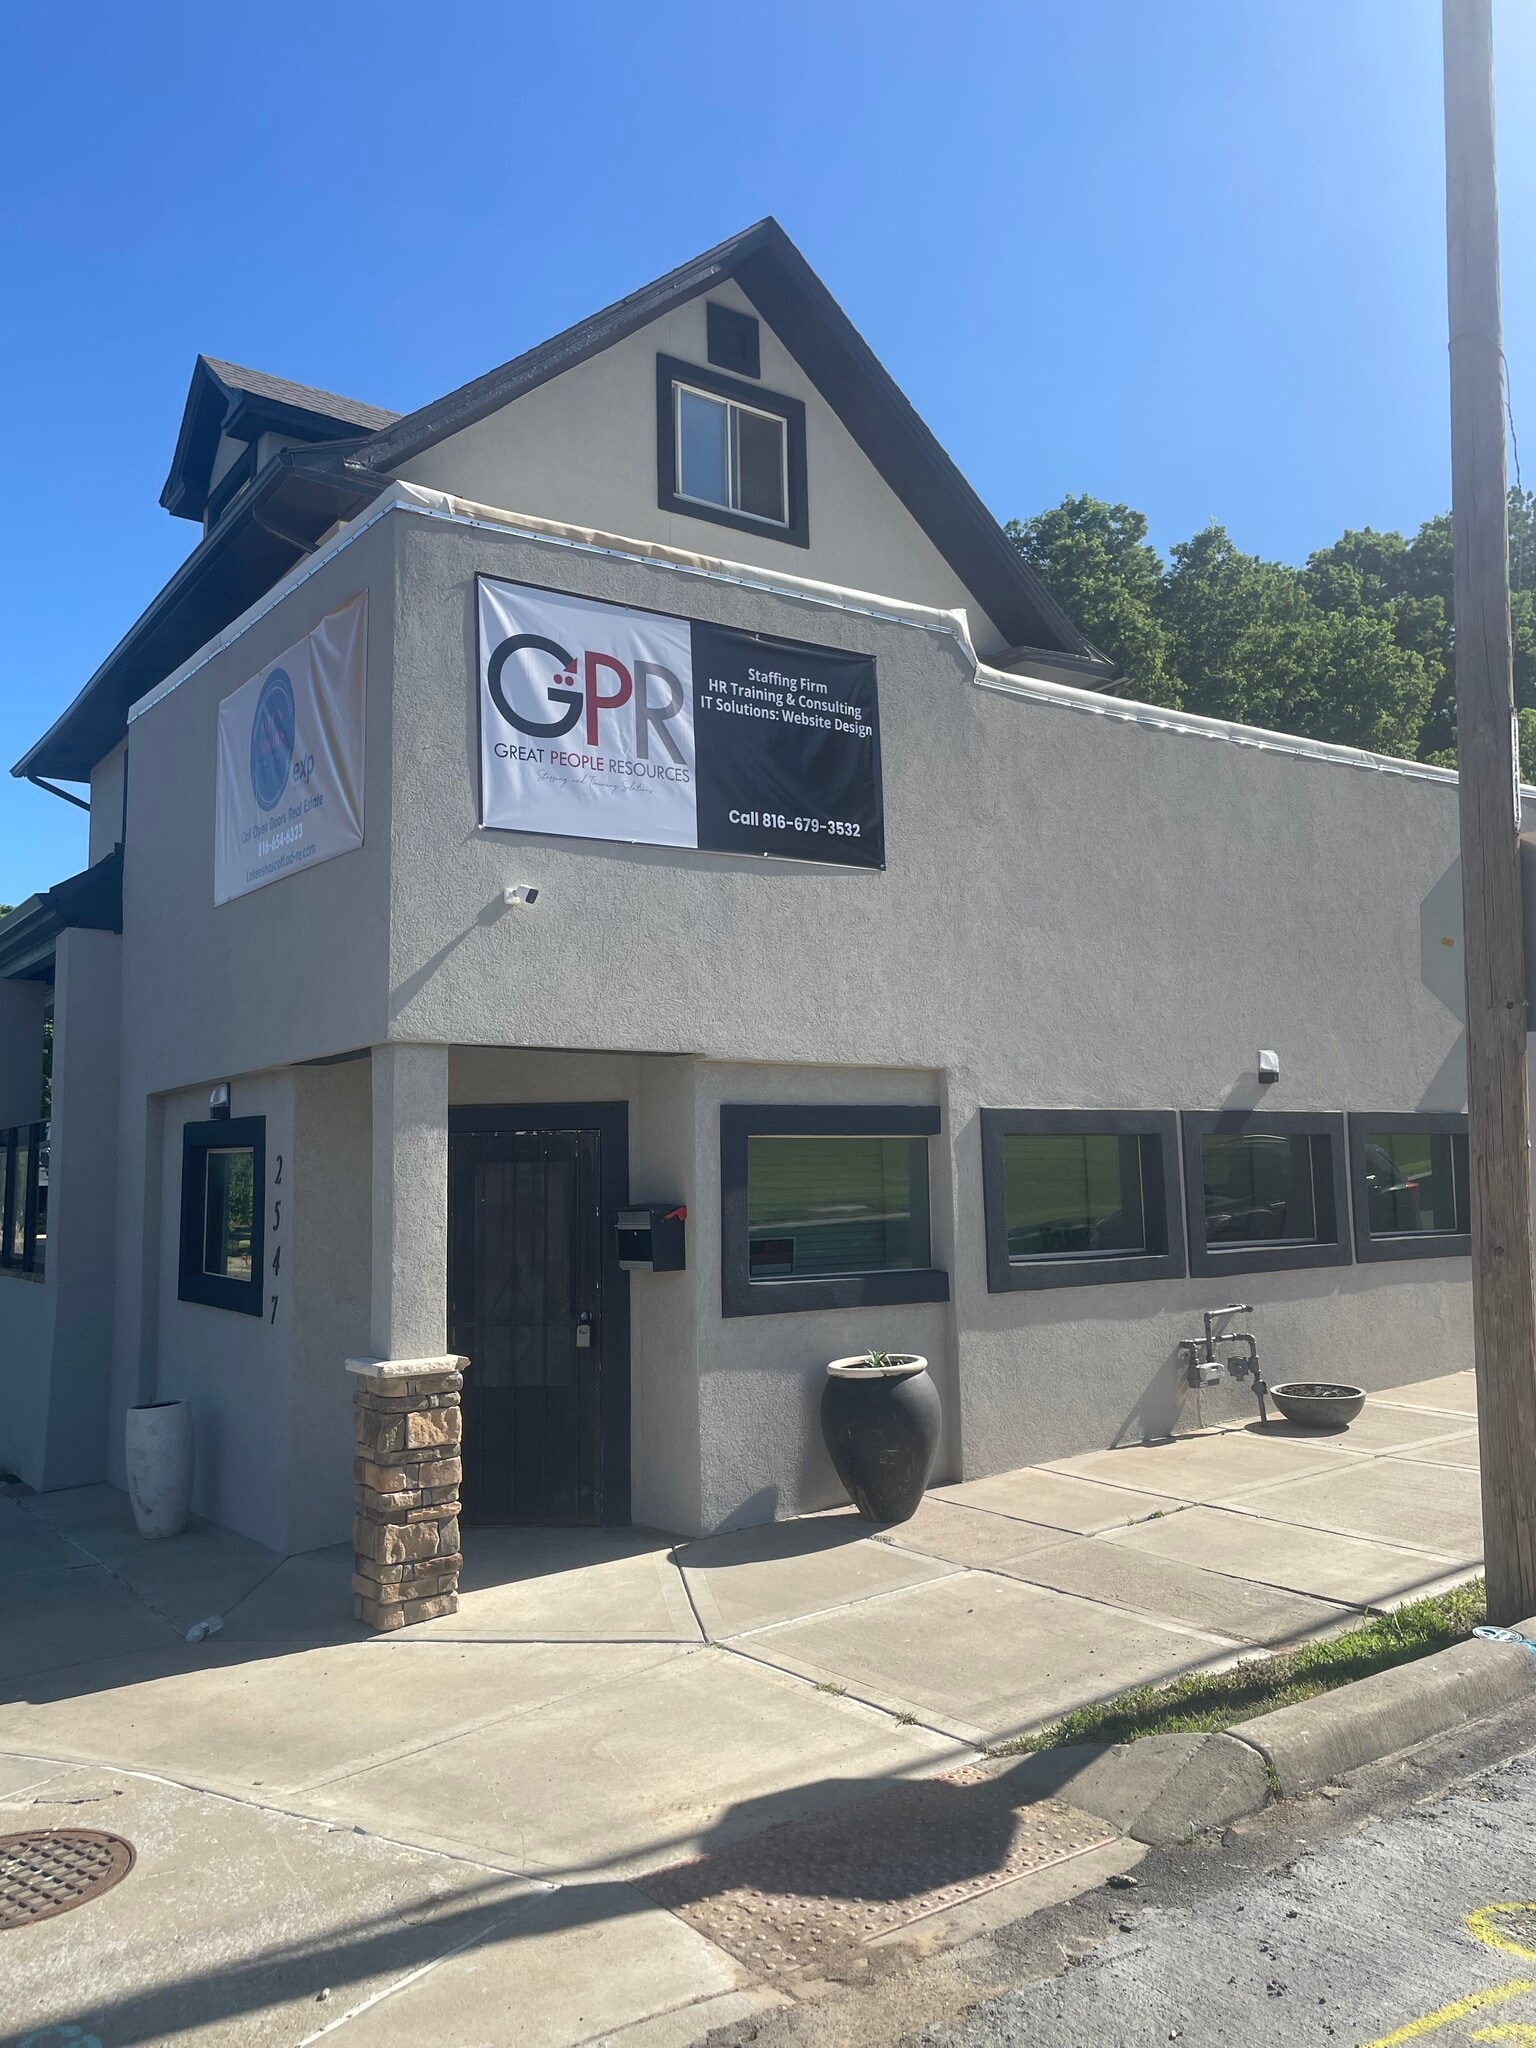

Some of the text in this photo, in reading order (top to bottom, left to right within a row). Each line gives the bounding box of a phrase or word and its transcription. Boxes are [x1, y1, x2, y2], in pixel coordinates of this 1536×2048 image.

[488, 633, 688, 766] GPR
[708, 678, 862, 720] HR Training & Consulting
[748, 668, 828, 694] Staffing Firm
[700, 695, 873, 738] IT Solutions: Website Design
[494, 742, 690, 783] GREAT PEOPLE RESOURCES
[252, 823, 269, 840] Open
[269, 813, 287, 830] Doors
[288, 801, 302, 821] Real
[303, 793, 324, 813] Estate
[728, 809, 862, 838] Call 816-679-3532
[257, 822, 303, 858] 816-654-6323
